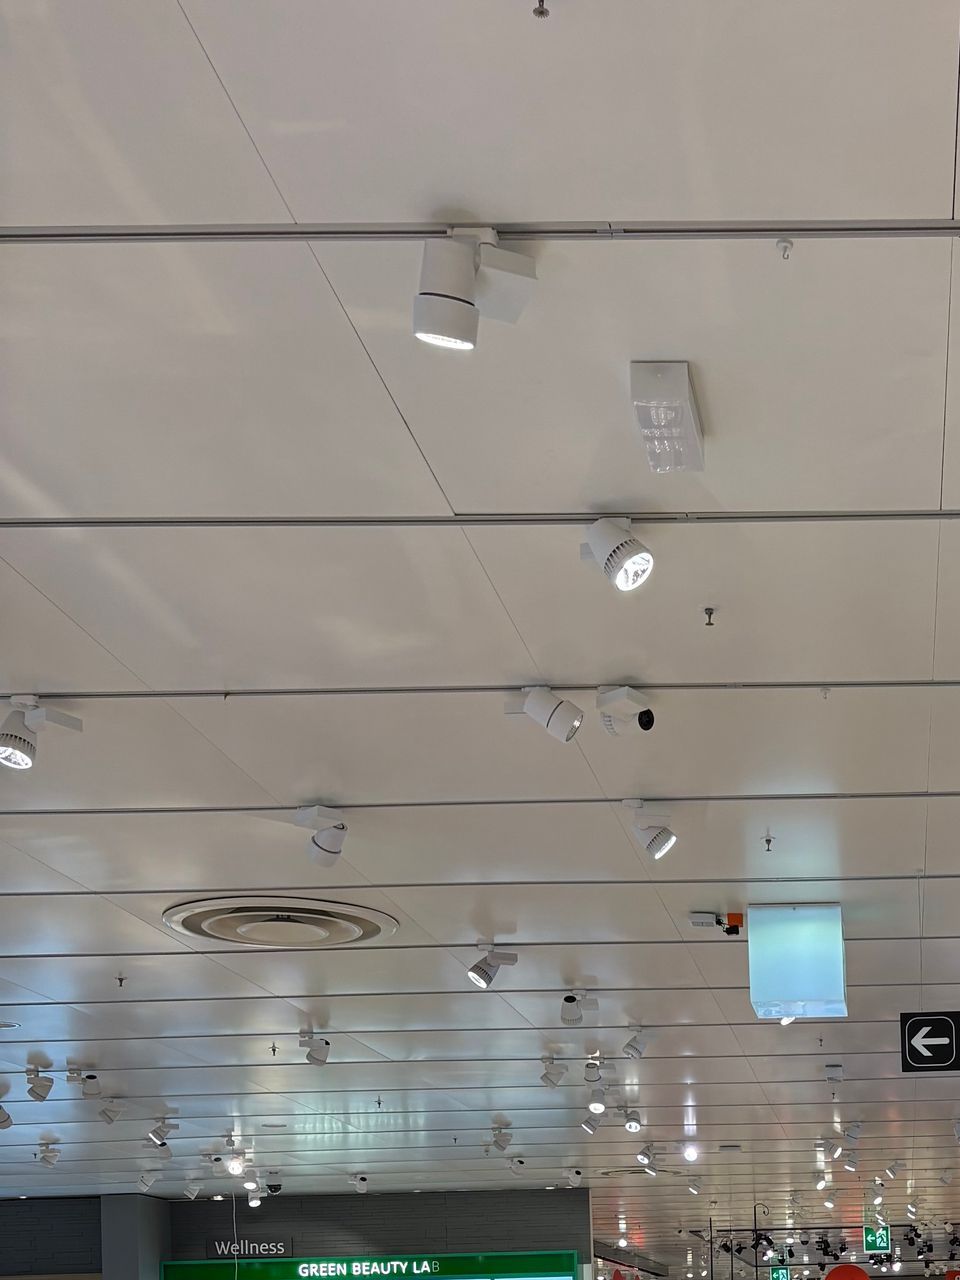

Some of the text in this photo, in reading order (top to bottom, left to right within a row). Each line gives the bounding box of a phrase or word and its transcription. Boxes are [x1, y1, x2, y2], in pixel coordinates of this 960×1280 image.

[215, 1240, 285, 1255] Wellness
[299, 1261, 440, 1277] GREEN BEAUTY LAB
